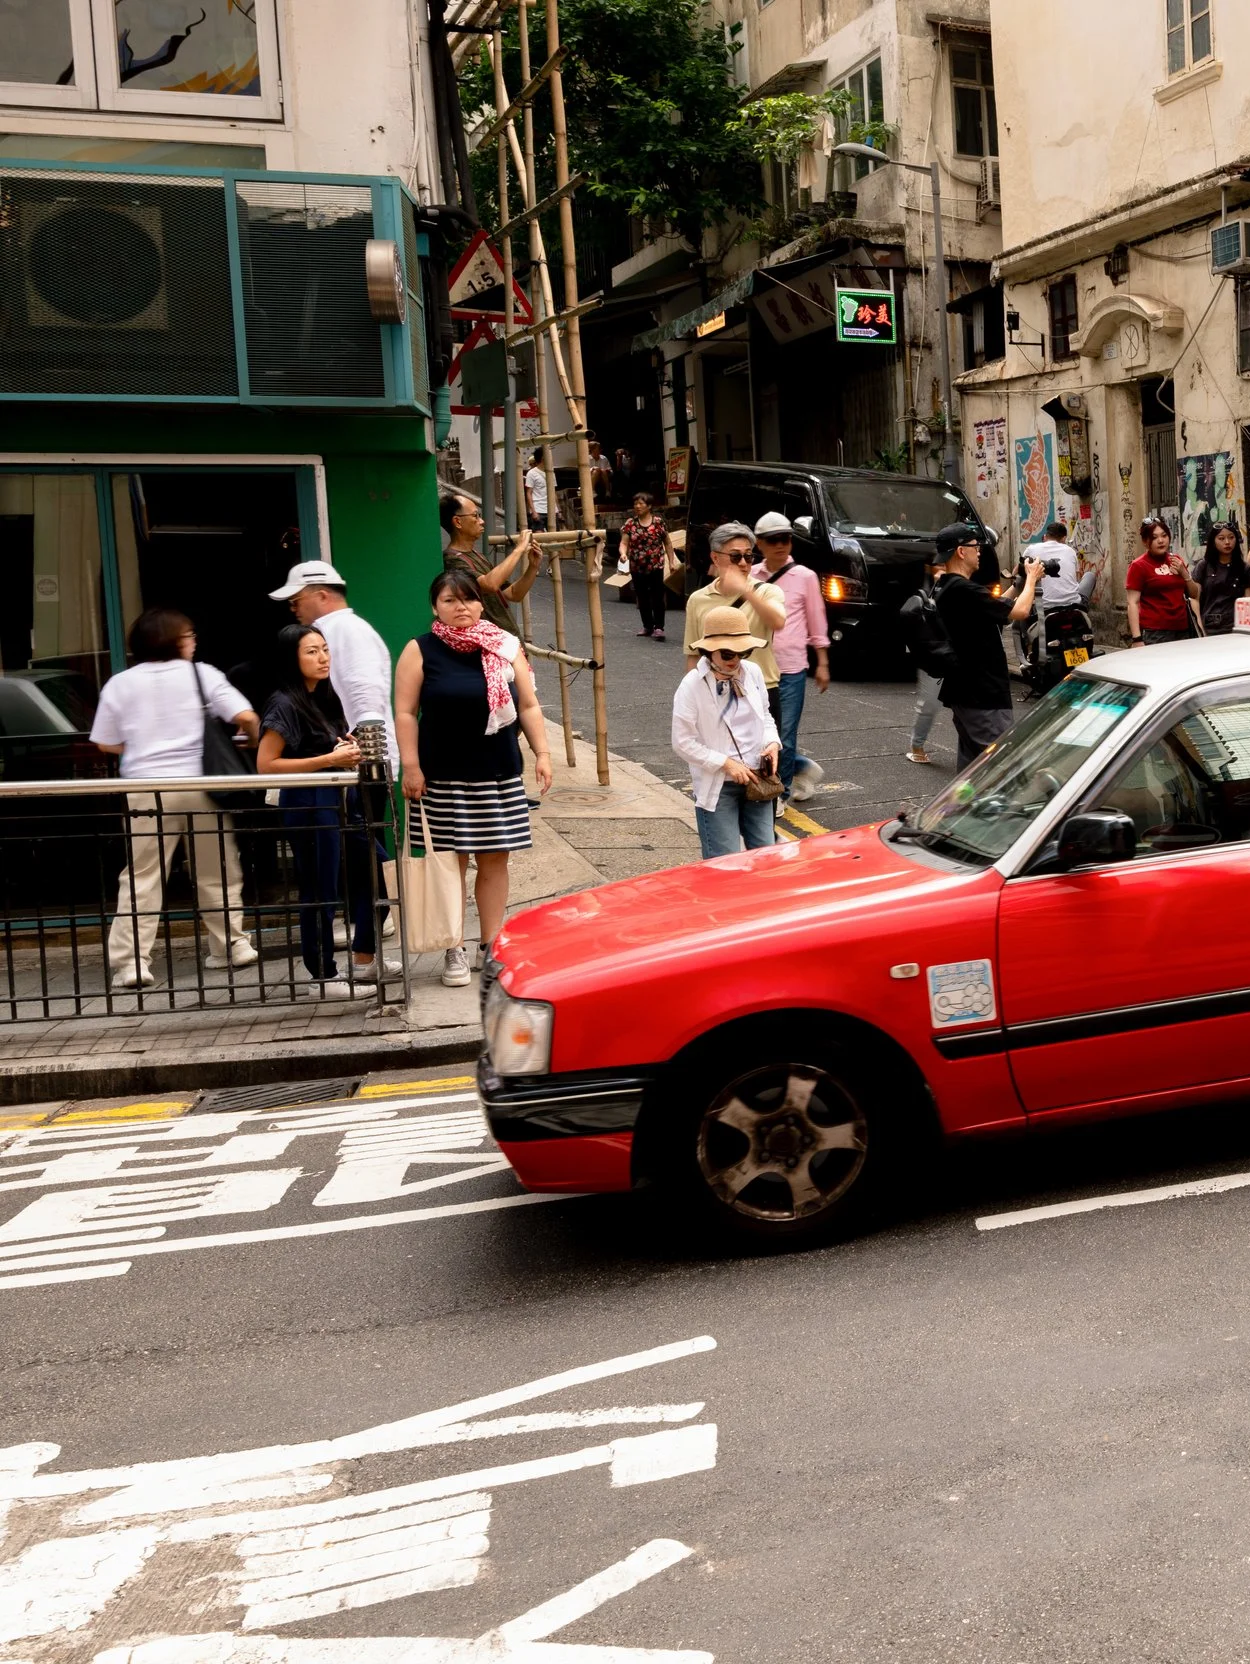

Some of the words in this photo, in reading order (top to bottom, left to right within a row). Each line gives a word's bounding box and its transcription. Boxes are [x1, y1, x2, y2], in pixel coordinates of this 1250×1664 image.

[467, 272, 496, 294] 1:5
[857, 303, 892, 328] 珍美
[1070, 650, 1082, 658] YL
[1070, 657, 1086, 665] 1601
